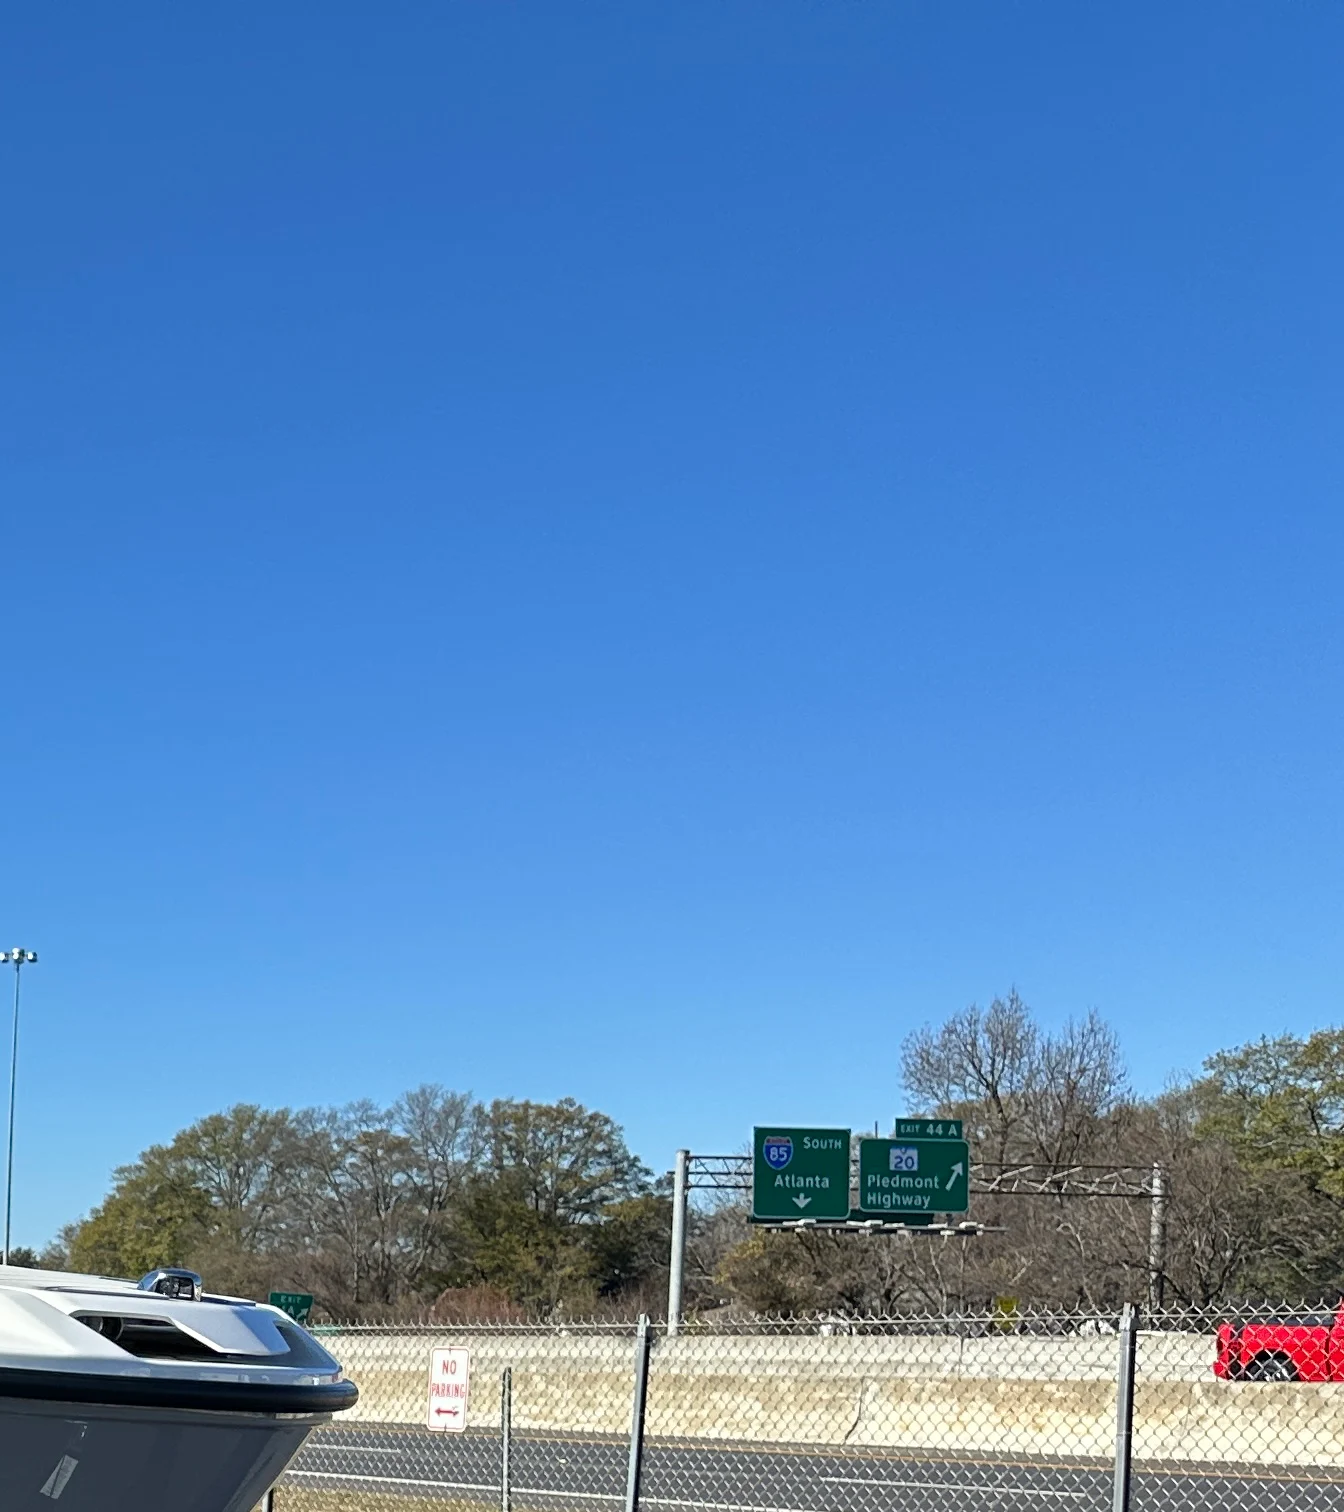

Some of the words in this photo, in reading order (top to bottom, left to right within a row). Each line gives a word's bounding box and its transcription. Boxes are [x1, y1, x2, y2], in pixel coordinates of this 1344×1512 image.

[900, 1124, 920, 1134] EXIT
[926, 1123, 943, 1136] 44
[948, 1123, 958, 1136] A
[802, 1136, 842, 1150] SOUTH
[769, 1146, 788, 1162] 85
[894, 1155, 915, 1170] 20
[774, 1173, 830, 1189] Atlanta
[867, 1174, 940, 1190] Piedmont
[867, 1191, 931, 1210] Highway
[280, 1294, 302, 1305] EXIT
[442, 1359, 457, 1376] NO
[431, 1382, 466, 1399] PARKING
